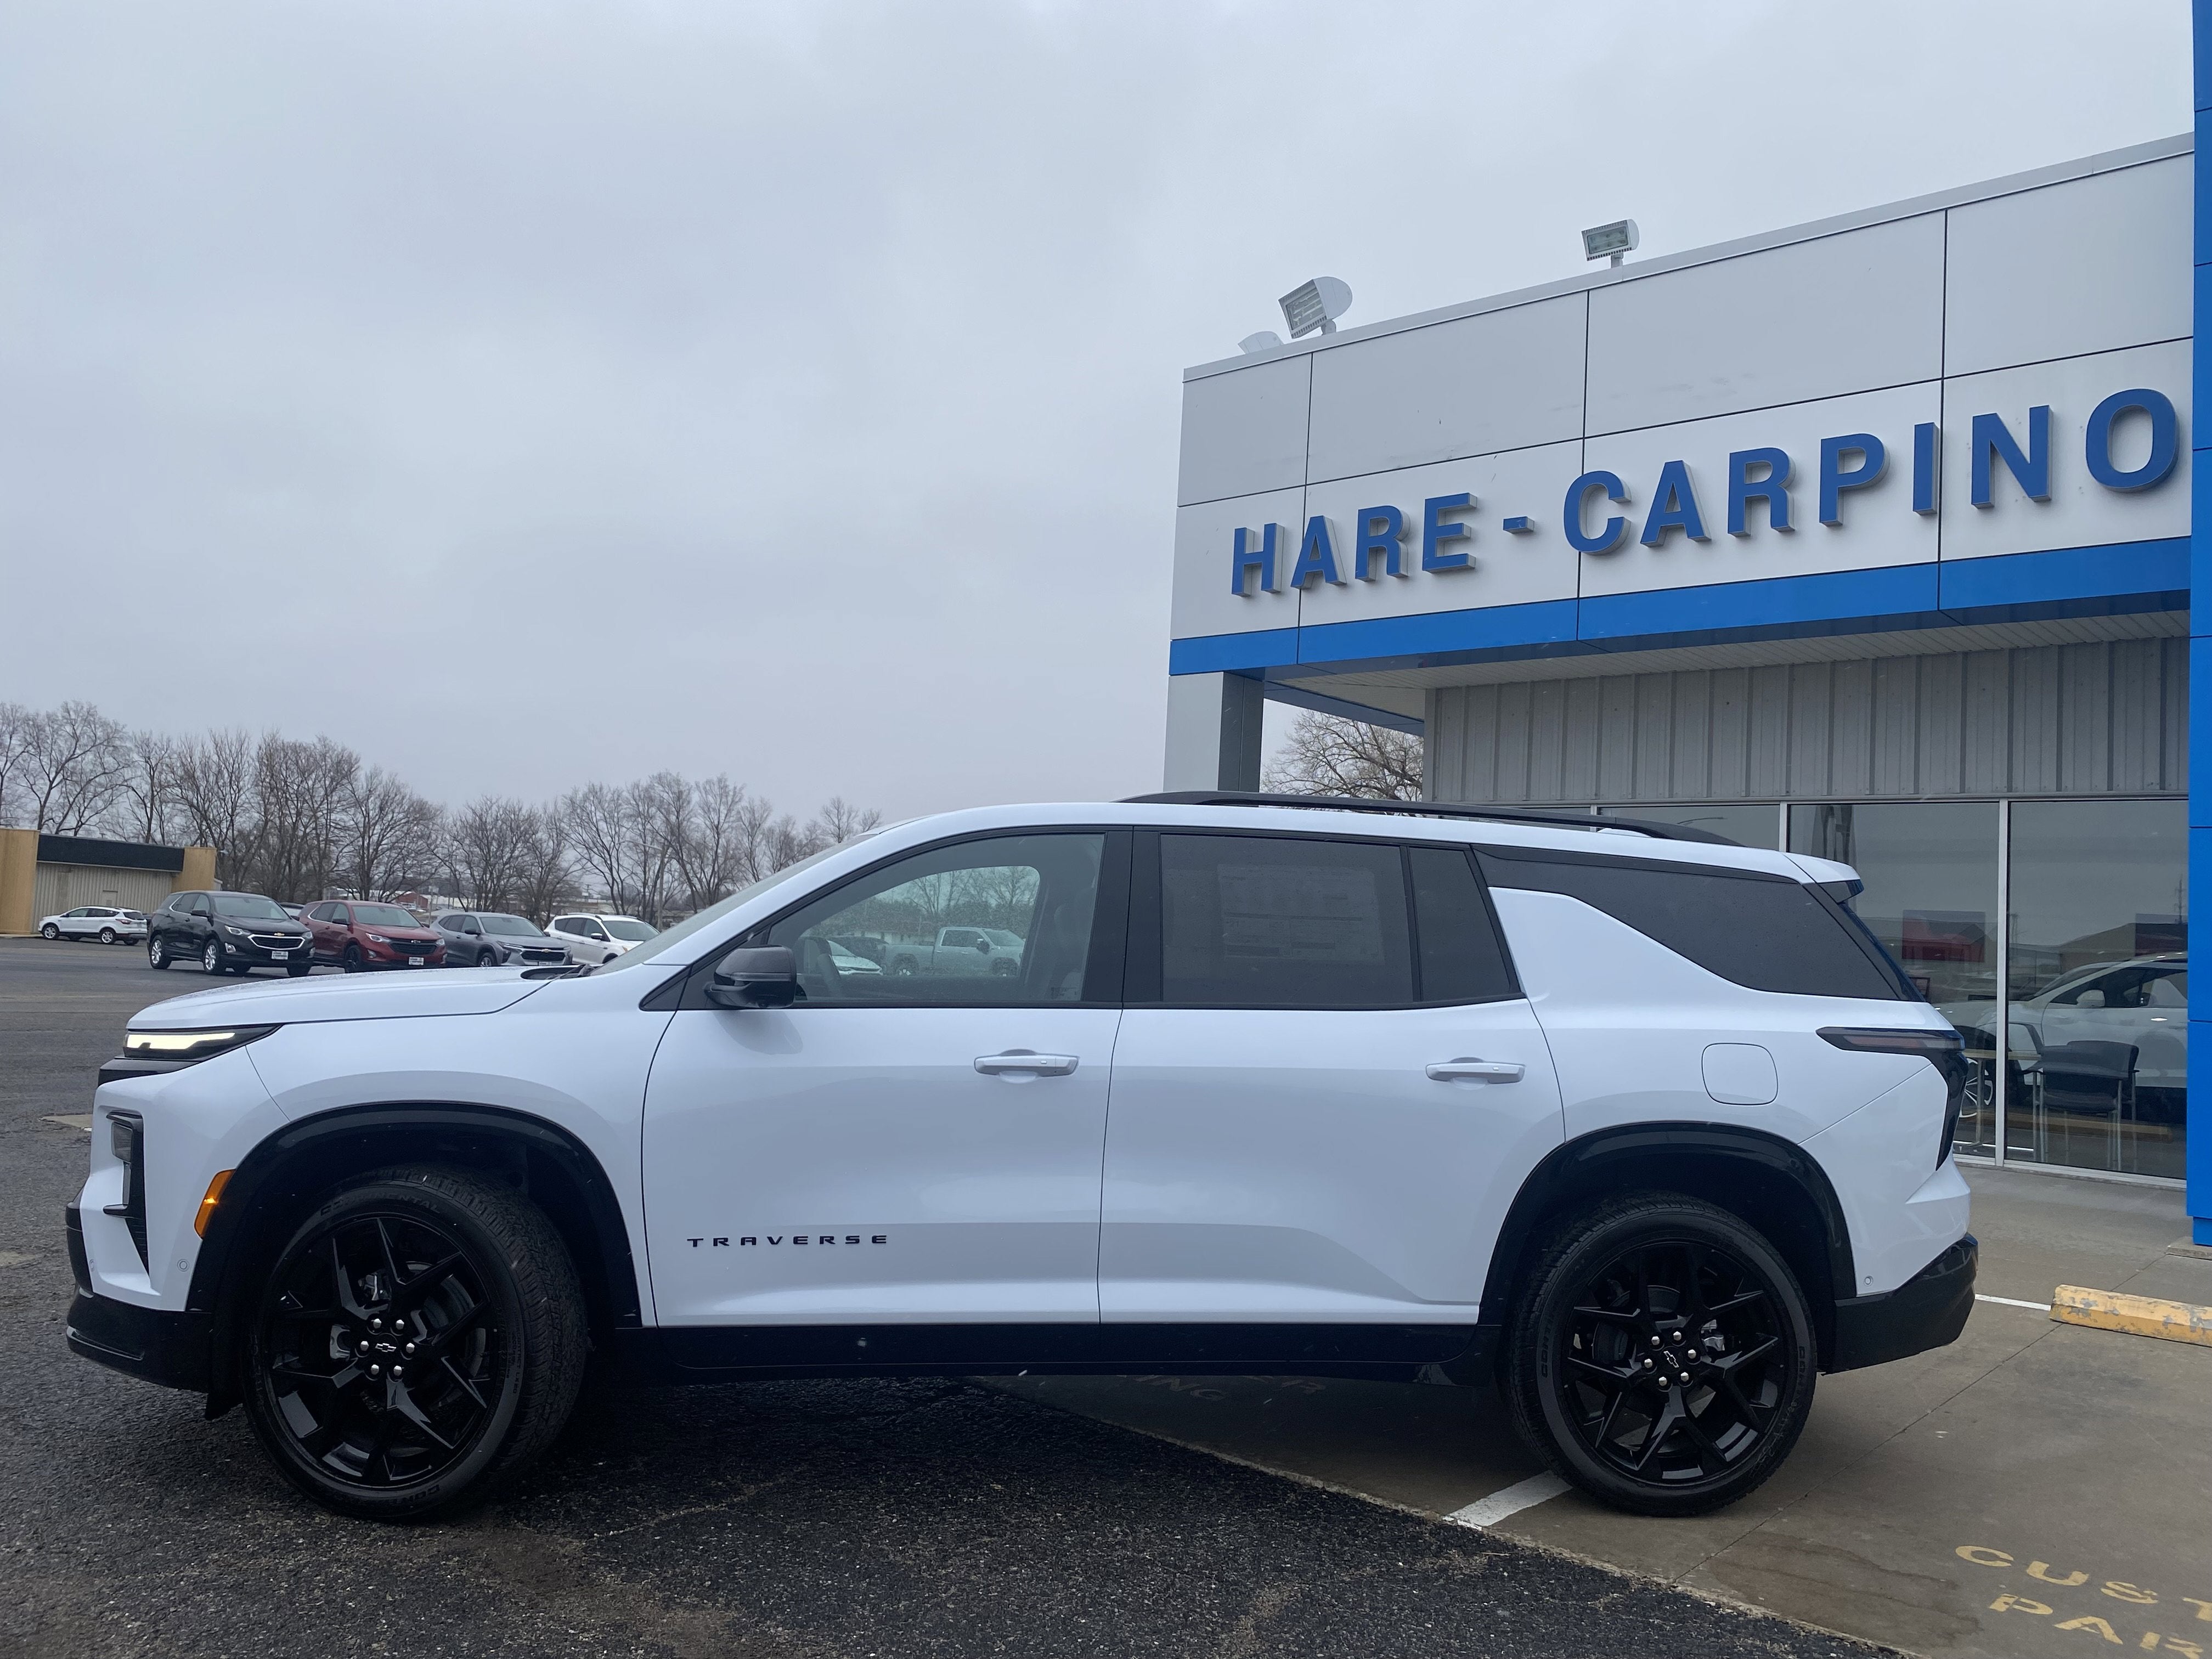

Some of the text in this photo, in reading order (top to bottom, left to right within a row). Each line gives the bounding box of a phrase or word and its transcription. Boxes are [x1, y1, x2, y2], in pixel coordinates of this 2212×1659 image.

[1232, 492, 1477, 596] HARE
[1563, 388, 2180, 555] CARPINO
[687, 1234, 887, 1248] TRAVERSE
